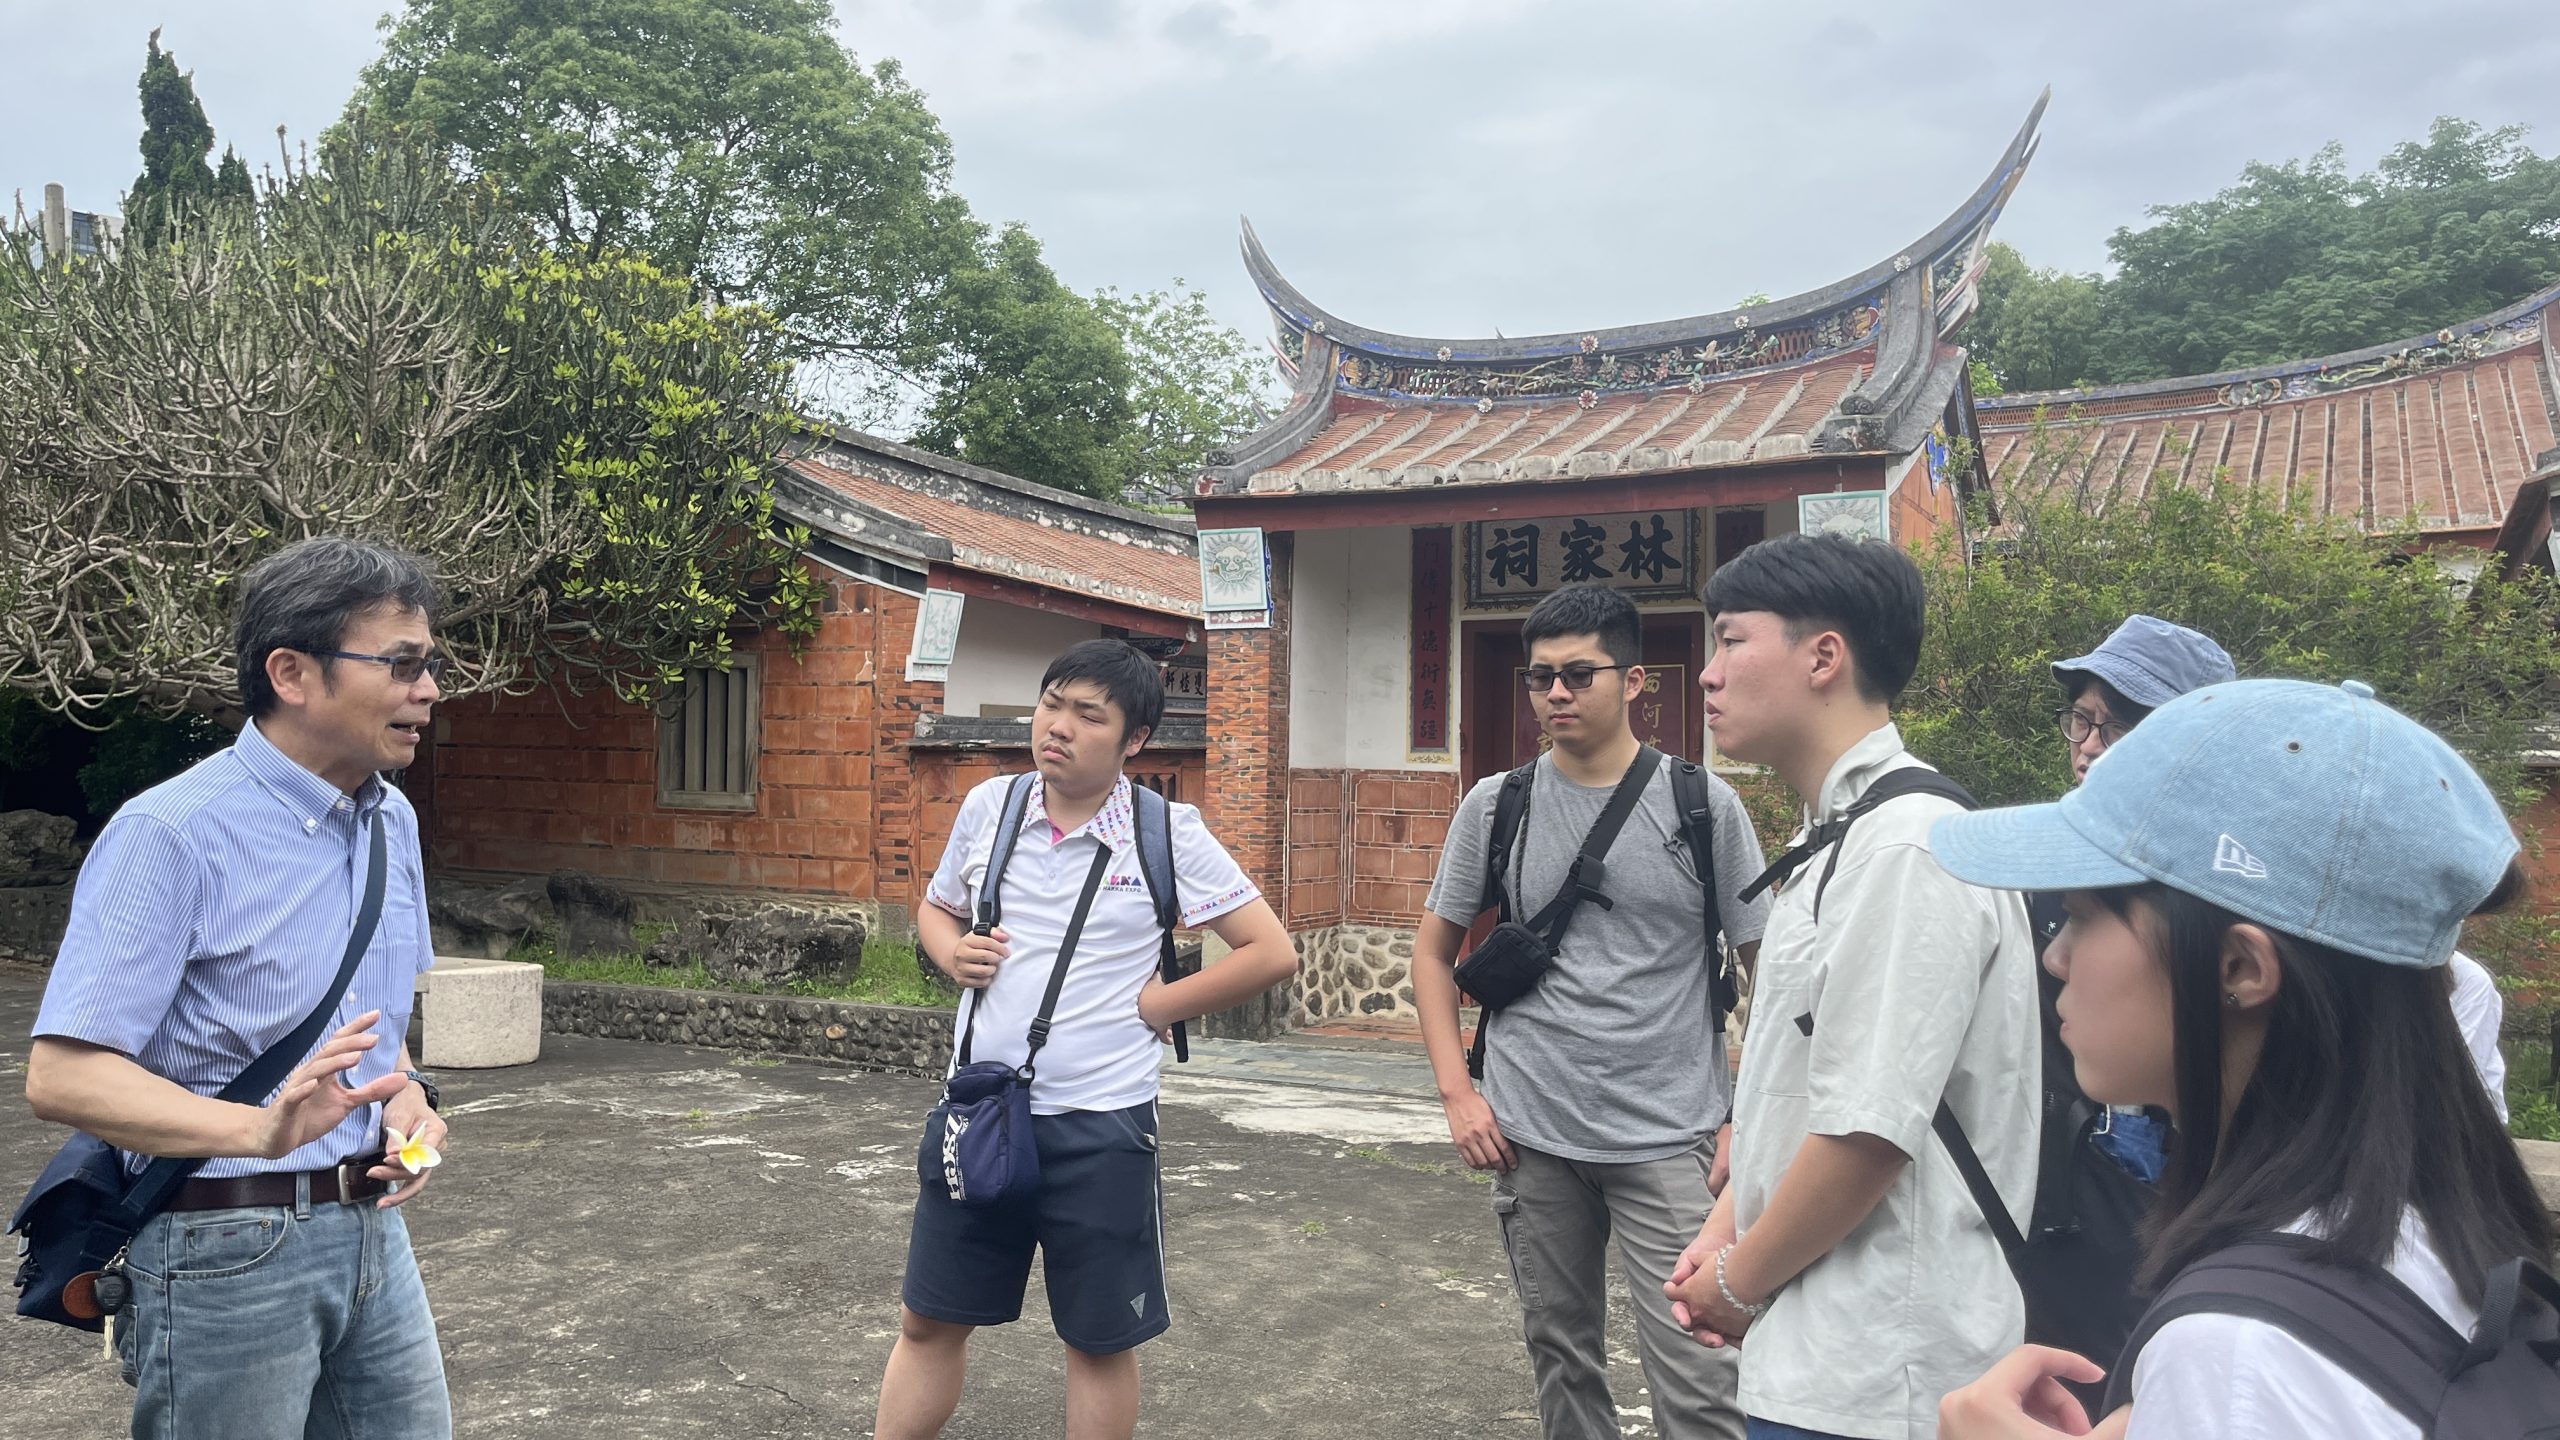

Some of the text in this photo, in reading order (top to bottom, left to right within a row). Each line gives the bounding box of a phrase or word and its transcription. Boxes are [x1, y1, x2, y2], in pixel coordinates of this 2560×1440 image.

[1485, 514, 1682, 587] 林家祠
[1103, 874, 1142, 886] AKKA
